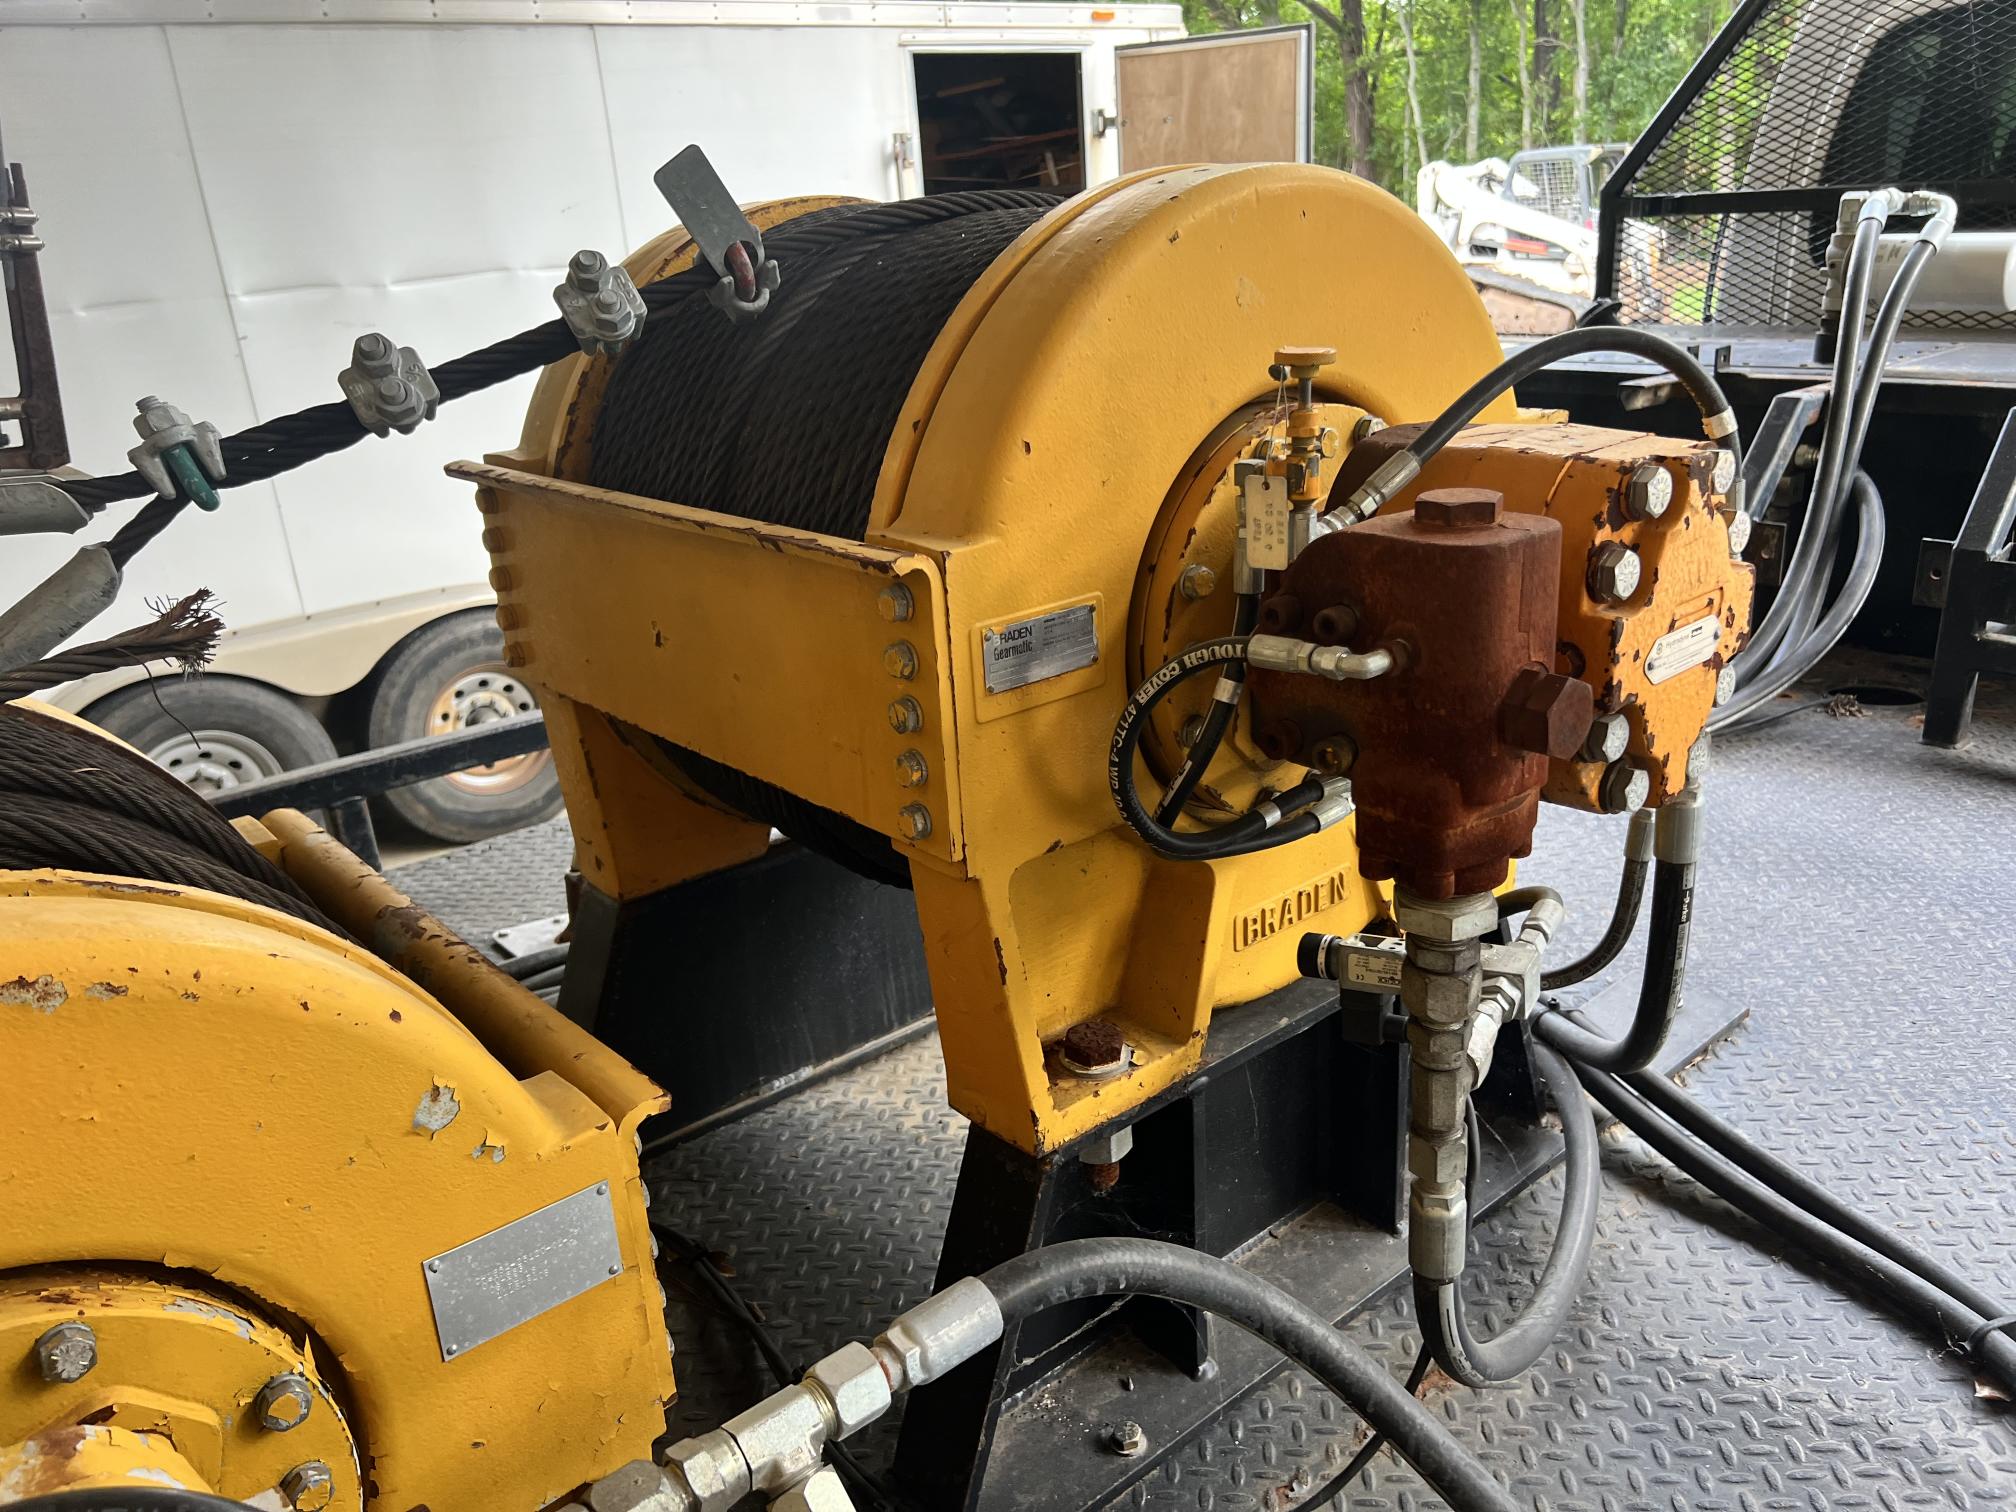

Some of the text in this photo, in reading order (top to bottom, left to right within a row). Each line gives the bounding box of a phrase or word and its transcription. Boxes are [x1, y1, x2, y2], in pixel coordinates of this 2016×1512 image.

[993, 625, 1034, 647] BRADEN
[993, 640, 1033, 662] Gearmatic
[1182, 644, 1246, 669] TOUGH
[1135, 661, 1183, 706] COVER
[1110, 702, 1137, 763] 471TC-4
[1109, 764, 1120, 790] WP
[1242, 871, 1345, 948] BRADEN
[1681, 891, 1691, 923] Parker
